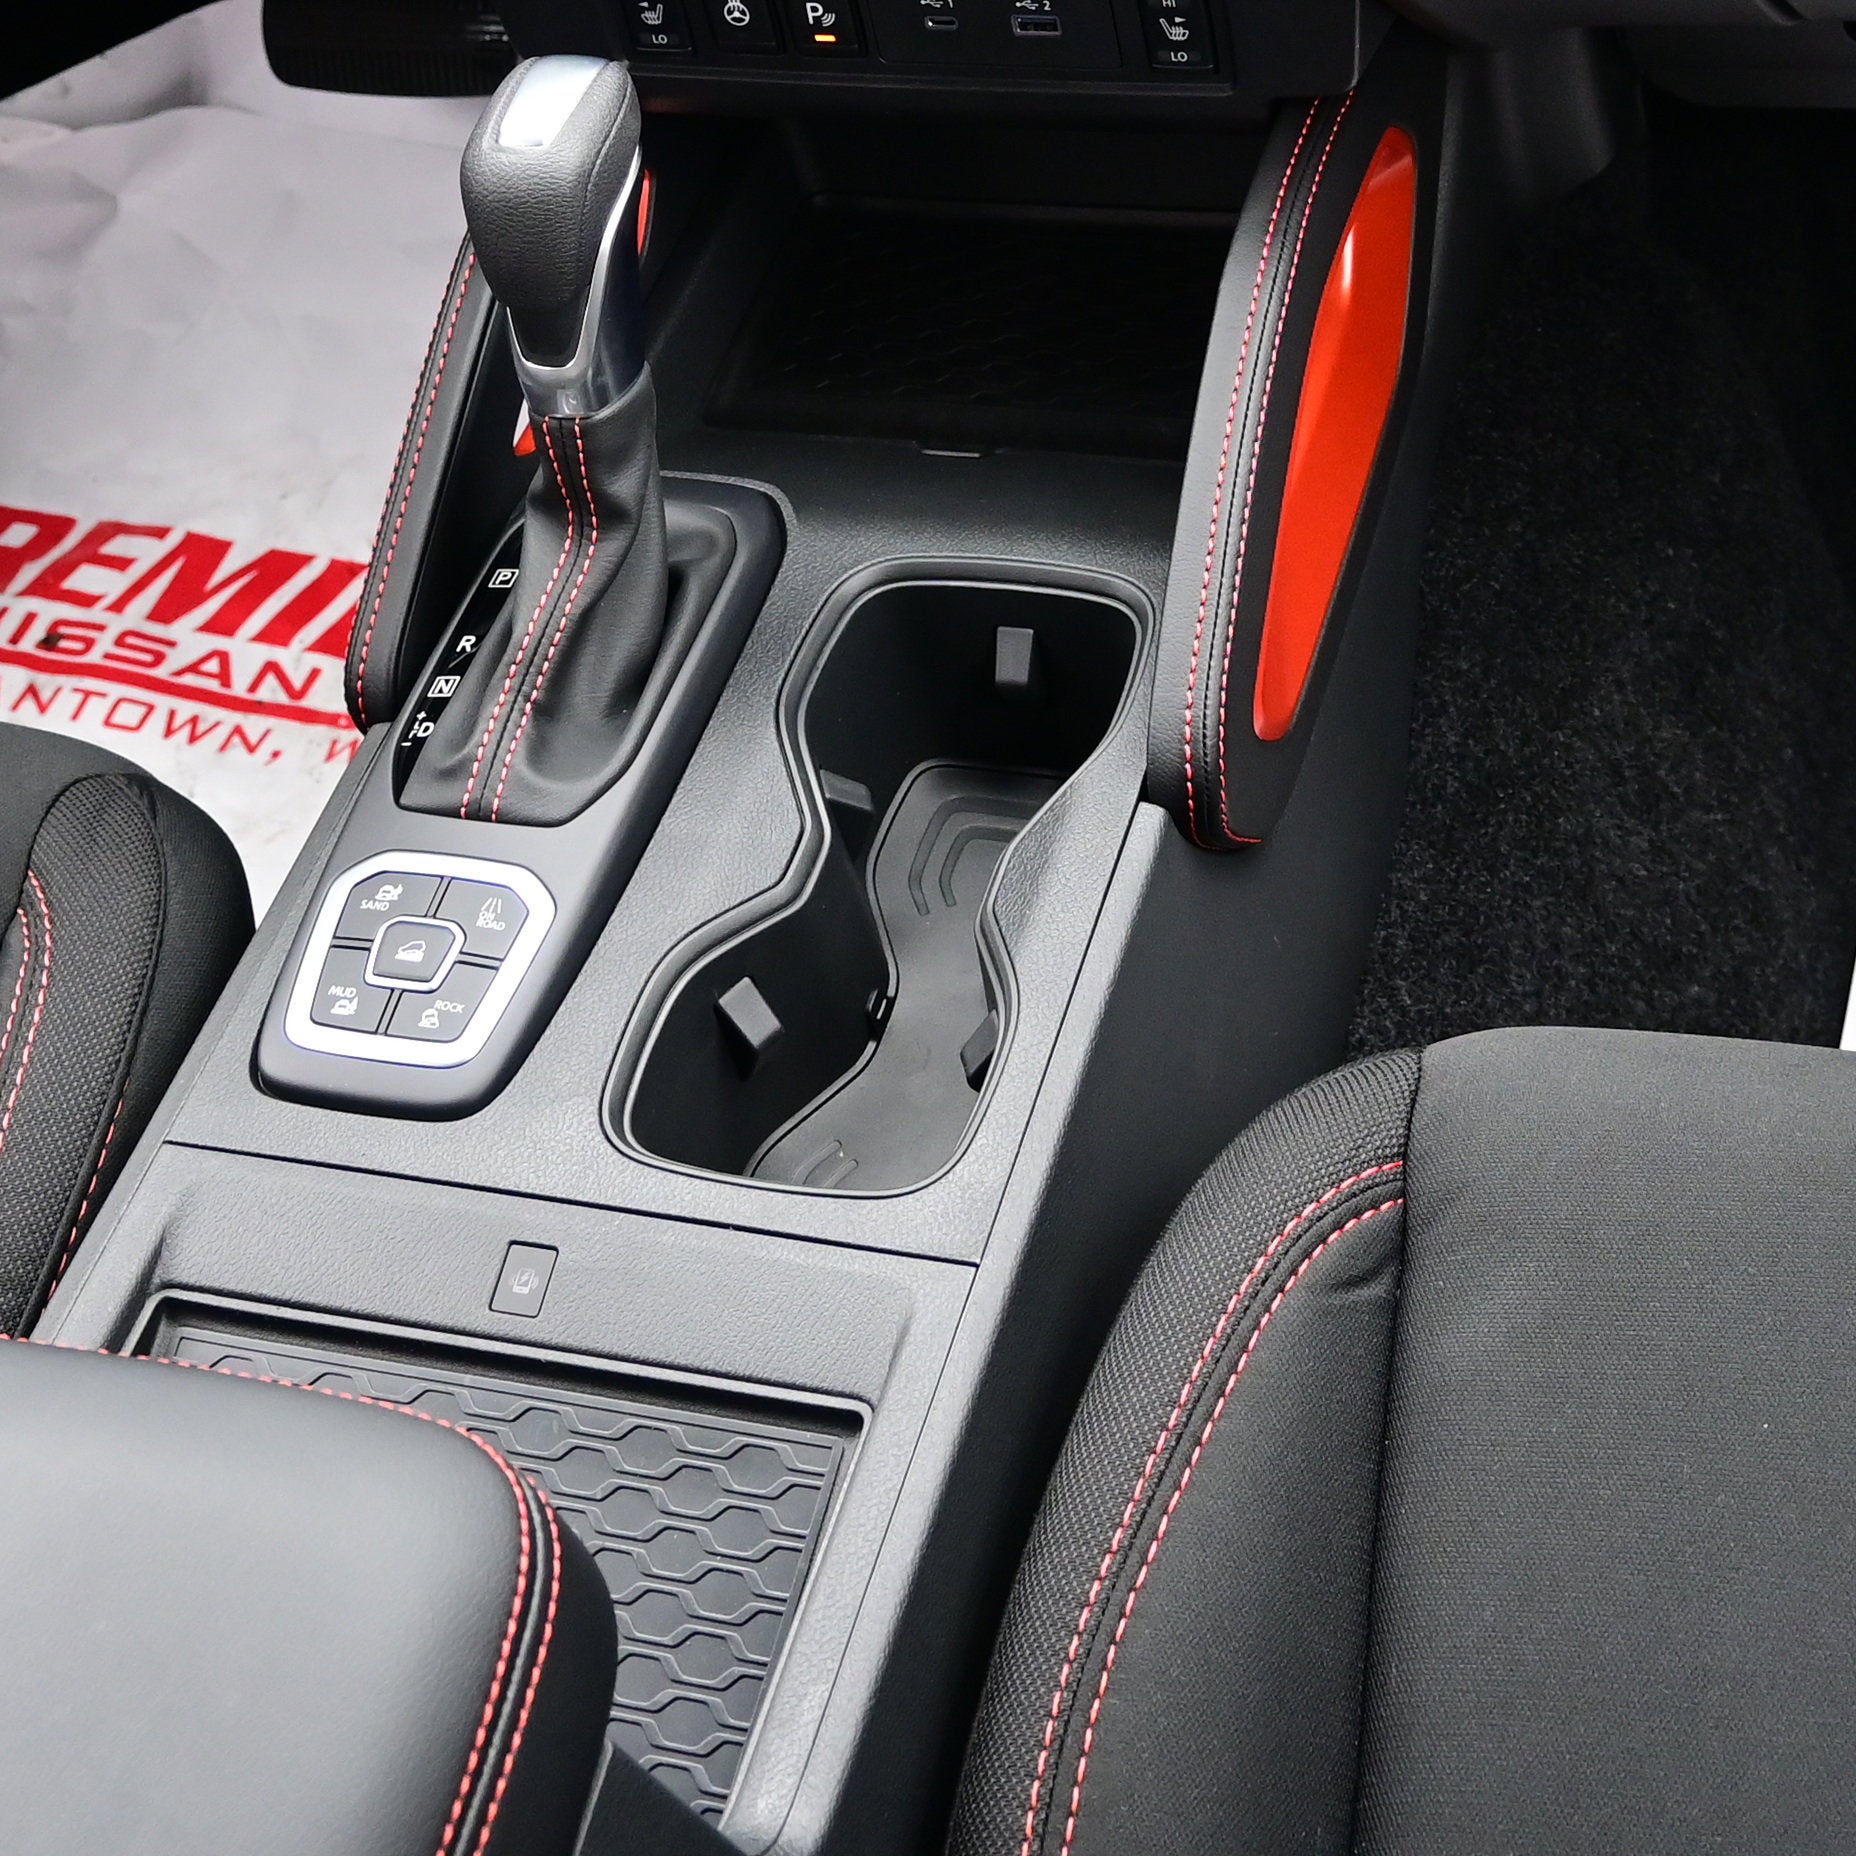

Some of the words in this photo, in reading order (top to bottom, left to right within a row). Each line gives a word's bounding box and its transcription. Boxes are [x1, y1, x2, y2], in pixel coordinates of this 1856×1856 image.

[1171, 51, 1187, 62] LO
[495, 572, 511, 584] P
[456, 636, 476, 652] R
[436, 679, 454, 693] N
[417, 722, 434, 737] D
[360, 900, 389, 911] SAND
[479, 911, 495, 920] ON
[476, 918, 506, 931] ROAD
[328, 986, 356, 998] MUD
[434, 1000, 465, 1013] ROCK
